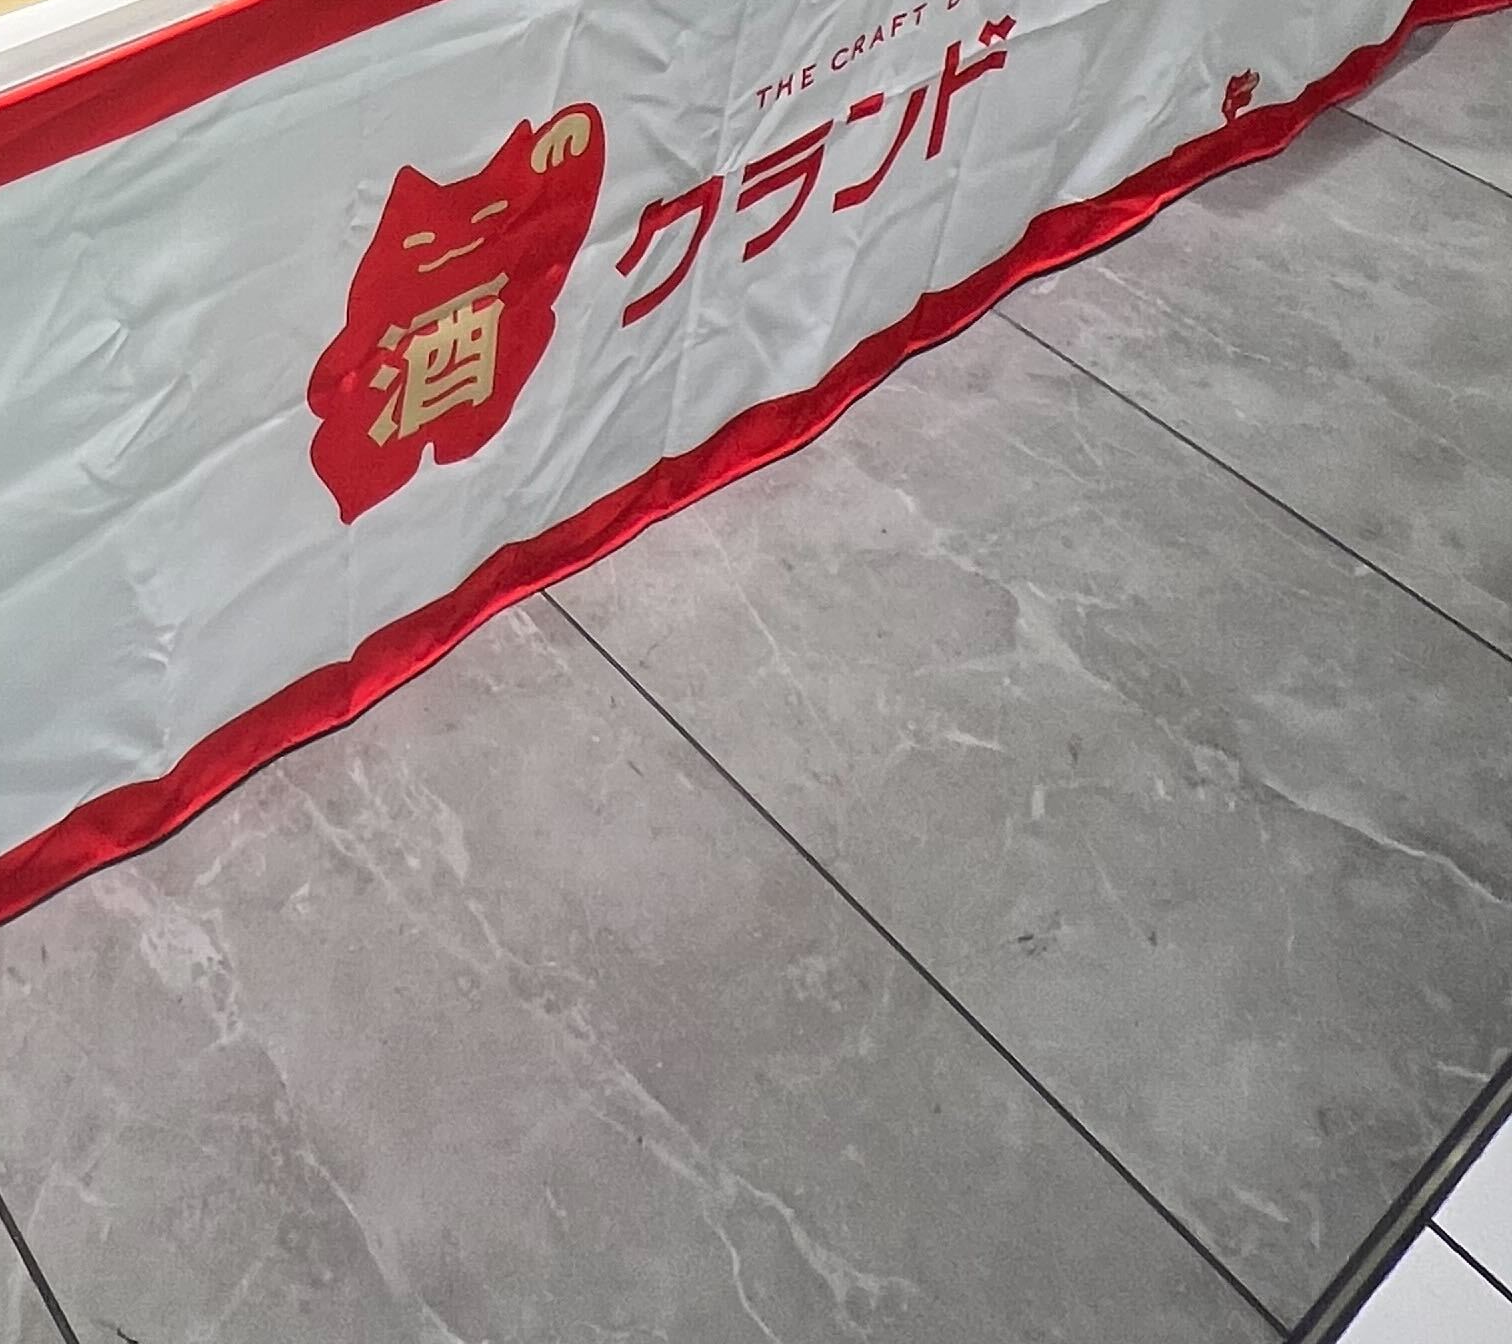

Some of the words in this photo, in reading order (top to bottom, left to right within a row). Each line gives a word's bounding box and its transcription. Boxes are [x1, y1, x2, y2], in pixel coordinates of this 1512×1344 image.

[756, 63, 817, 110] THE
[830, 2, 930, 72] CRAFT
[615, 14, 1018, 329] クランド
[366, 272, 511, 448] 酒
